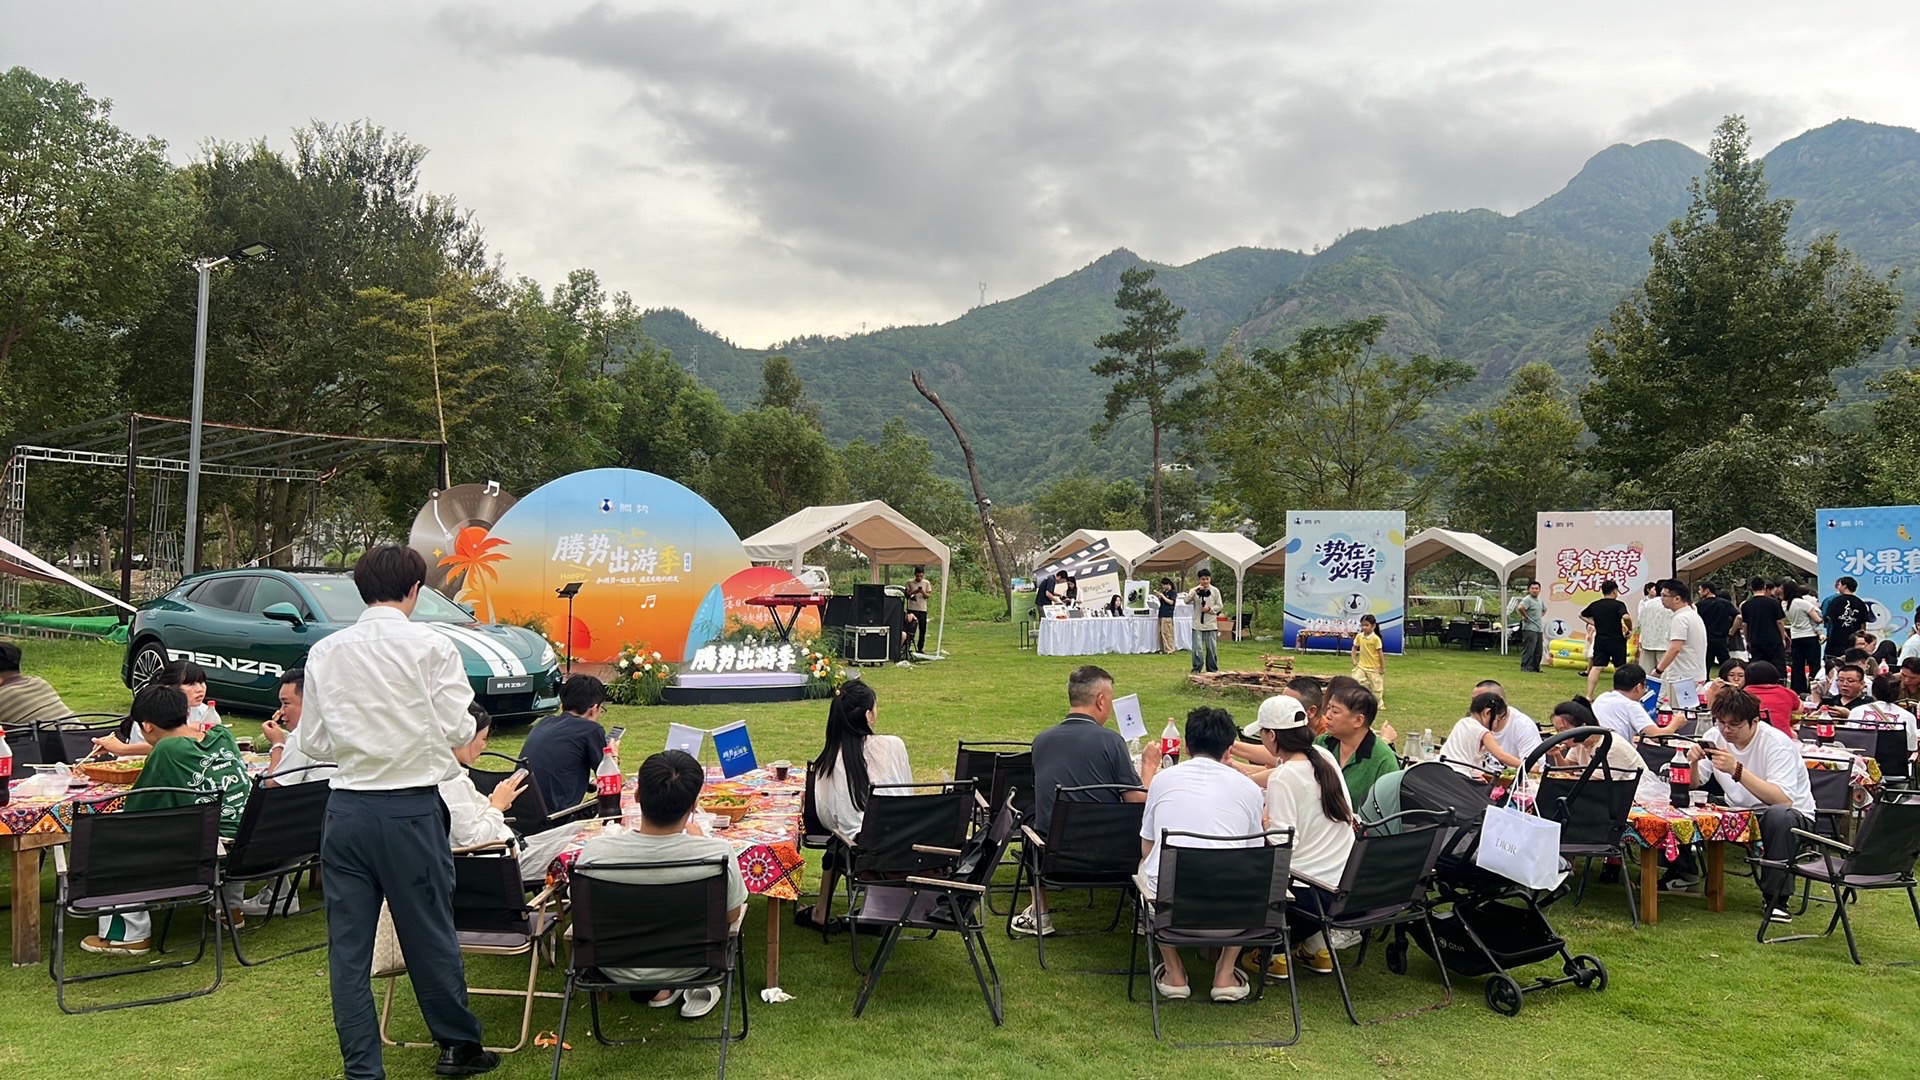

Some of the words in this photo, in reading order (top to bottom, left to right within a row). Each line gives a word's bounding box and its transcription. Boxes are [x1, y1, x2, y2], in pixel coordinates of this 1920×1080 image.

[551, 533, 681, 575] 腾势出游季
[1319, 539, 1366, 566] 势在
[1557, 548, 1641, 571] 零食铲铲
[560, 572, 586, 582] Happy
[1328, 560, 1375, 584] 必得
[1873, 575, 1913, 585] FRUIT
[166, 648, 286, 678] DENZA
[690, 644, 796, 673] 腾势出游季
[1495, 838, 1517, 856] DIOR
